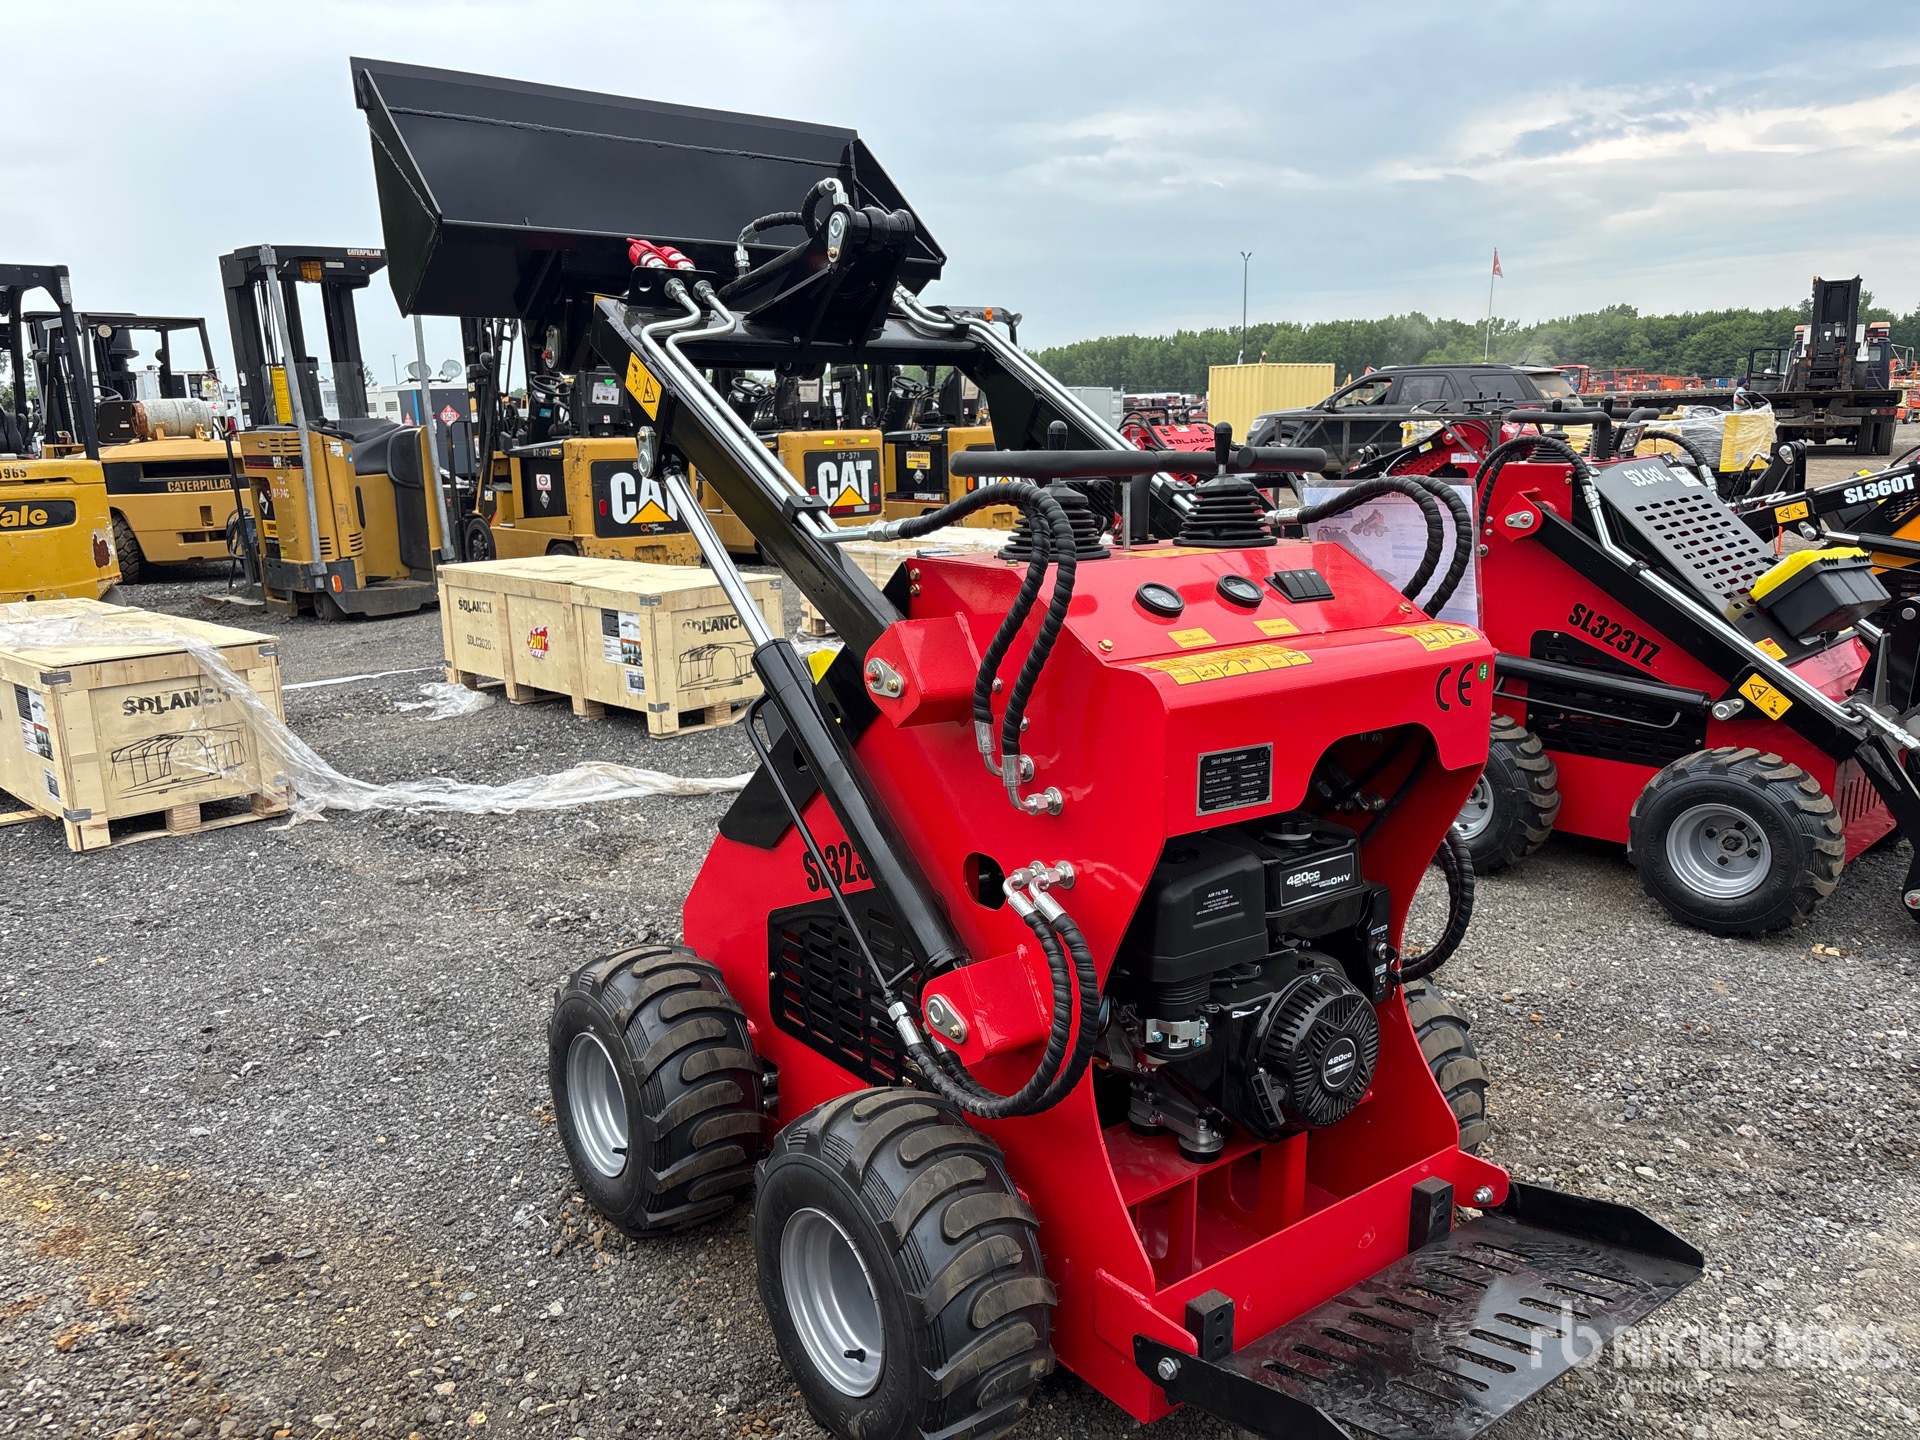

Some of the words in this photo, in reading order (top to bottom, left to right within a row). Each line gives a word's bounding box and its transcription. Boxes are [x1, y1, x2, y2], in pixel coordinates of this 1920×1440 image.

[346, 248, 382, 257] CATERPILLAR
[836, 451, 860, 460] 87-371
[167, 478, 232, 492] CATERPILLAR
[817, 460, 872, 508] CAT
[1843, 473, 1915, 504] SL360T
[529, 634, 546, 649] HOT
[1567, 602, 1662, 668] SL323TZ
[1435, 662, 1474, 711] CE
[1232, 754, 1248, 762] Loader
[1286, 870, 1320, 886] 420cc
[1330, 873, 1351, 885] OHV
[1327, 1052, 1352, 1066] 420cc
